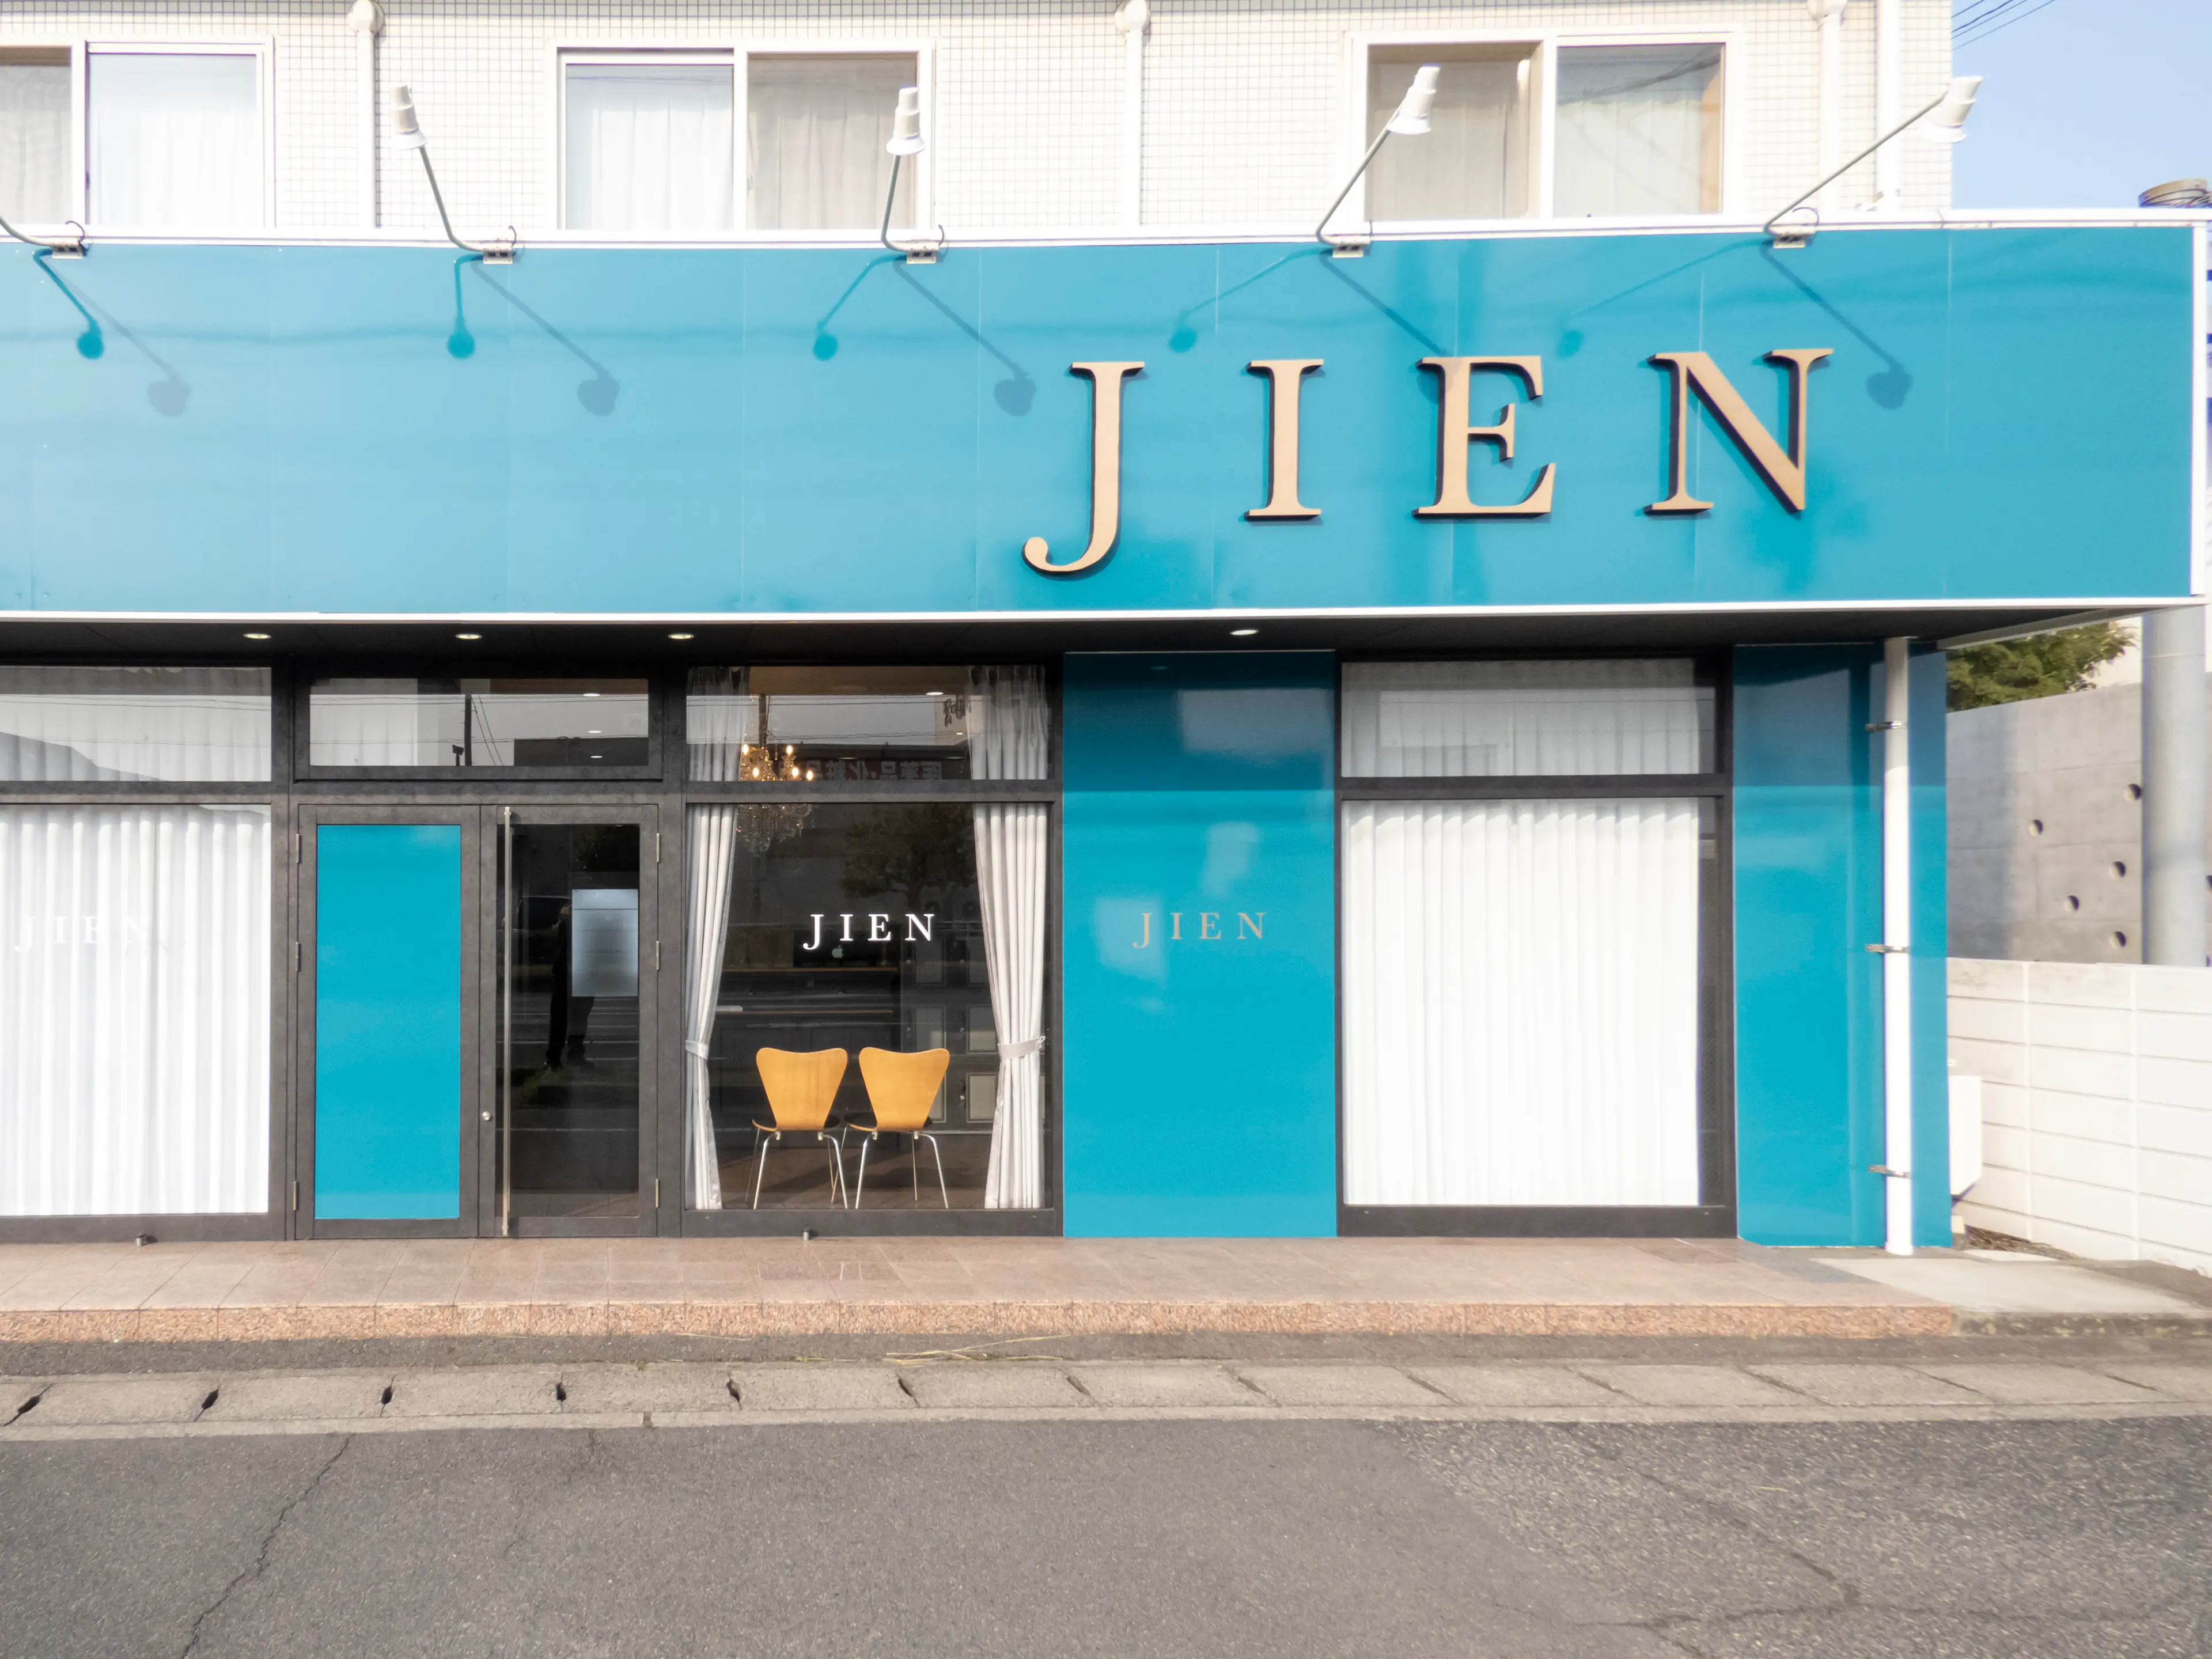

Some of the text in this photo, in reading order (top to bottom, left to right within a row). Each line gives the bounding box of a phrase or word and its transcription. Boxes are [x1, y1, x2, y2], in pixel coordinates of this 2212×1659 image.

[1022, 347, 1834, 576] JIEN
[802, 913, 935, 951] JIEN
[1132, 911, 1266, 949] JIEN
